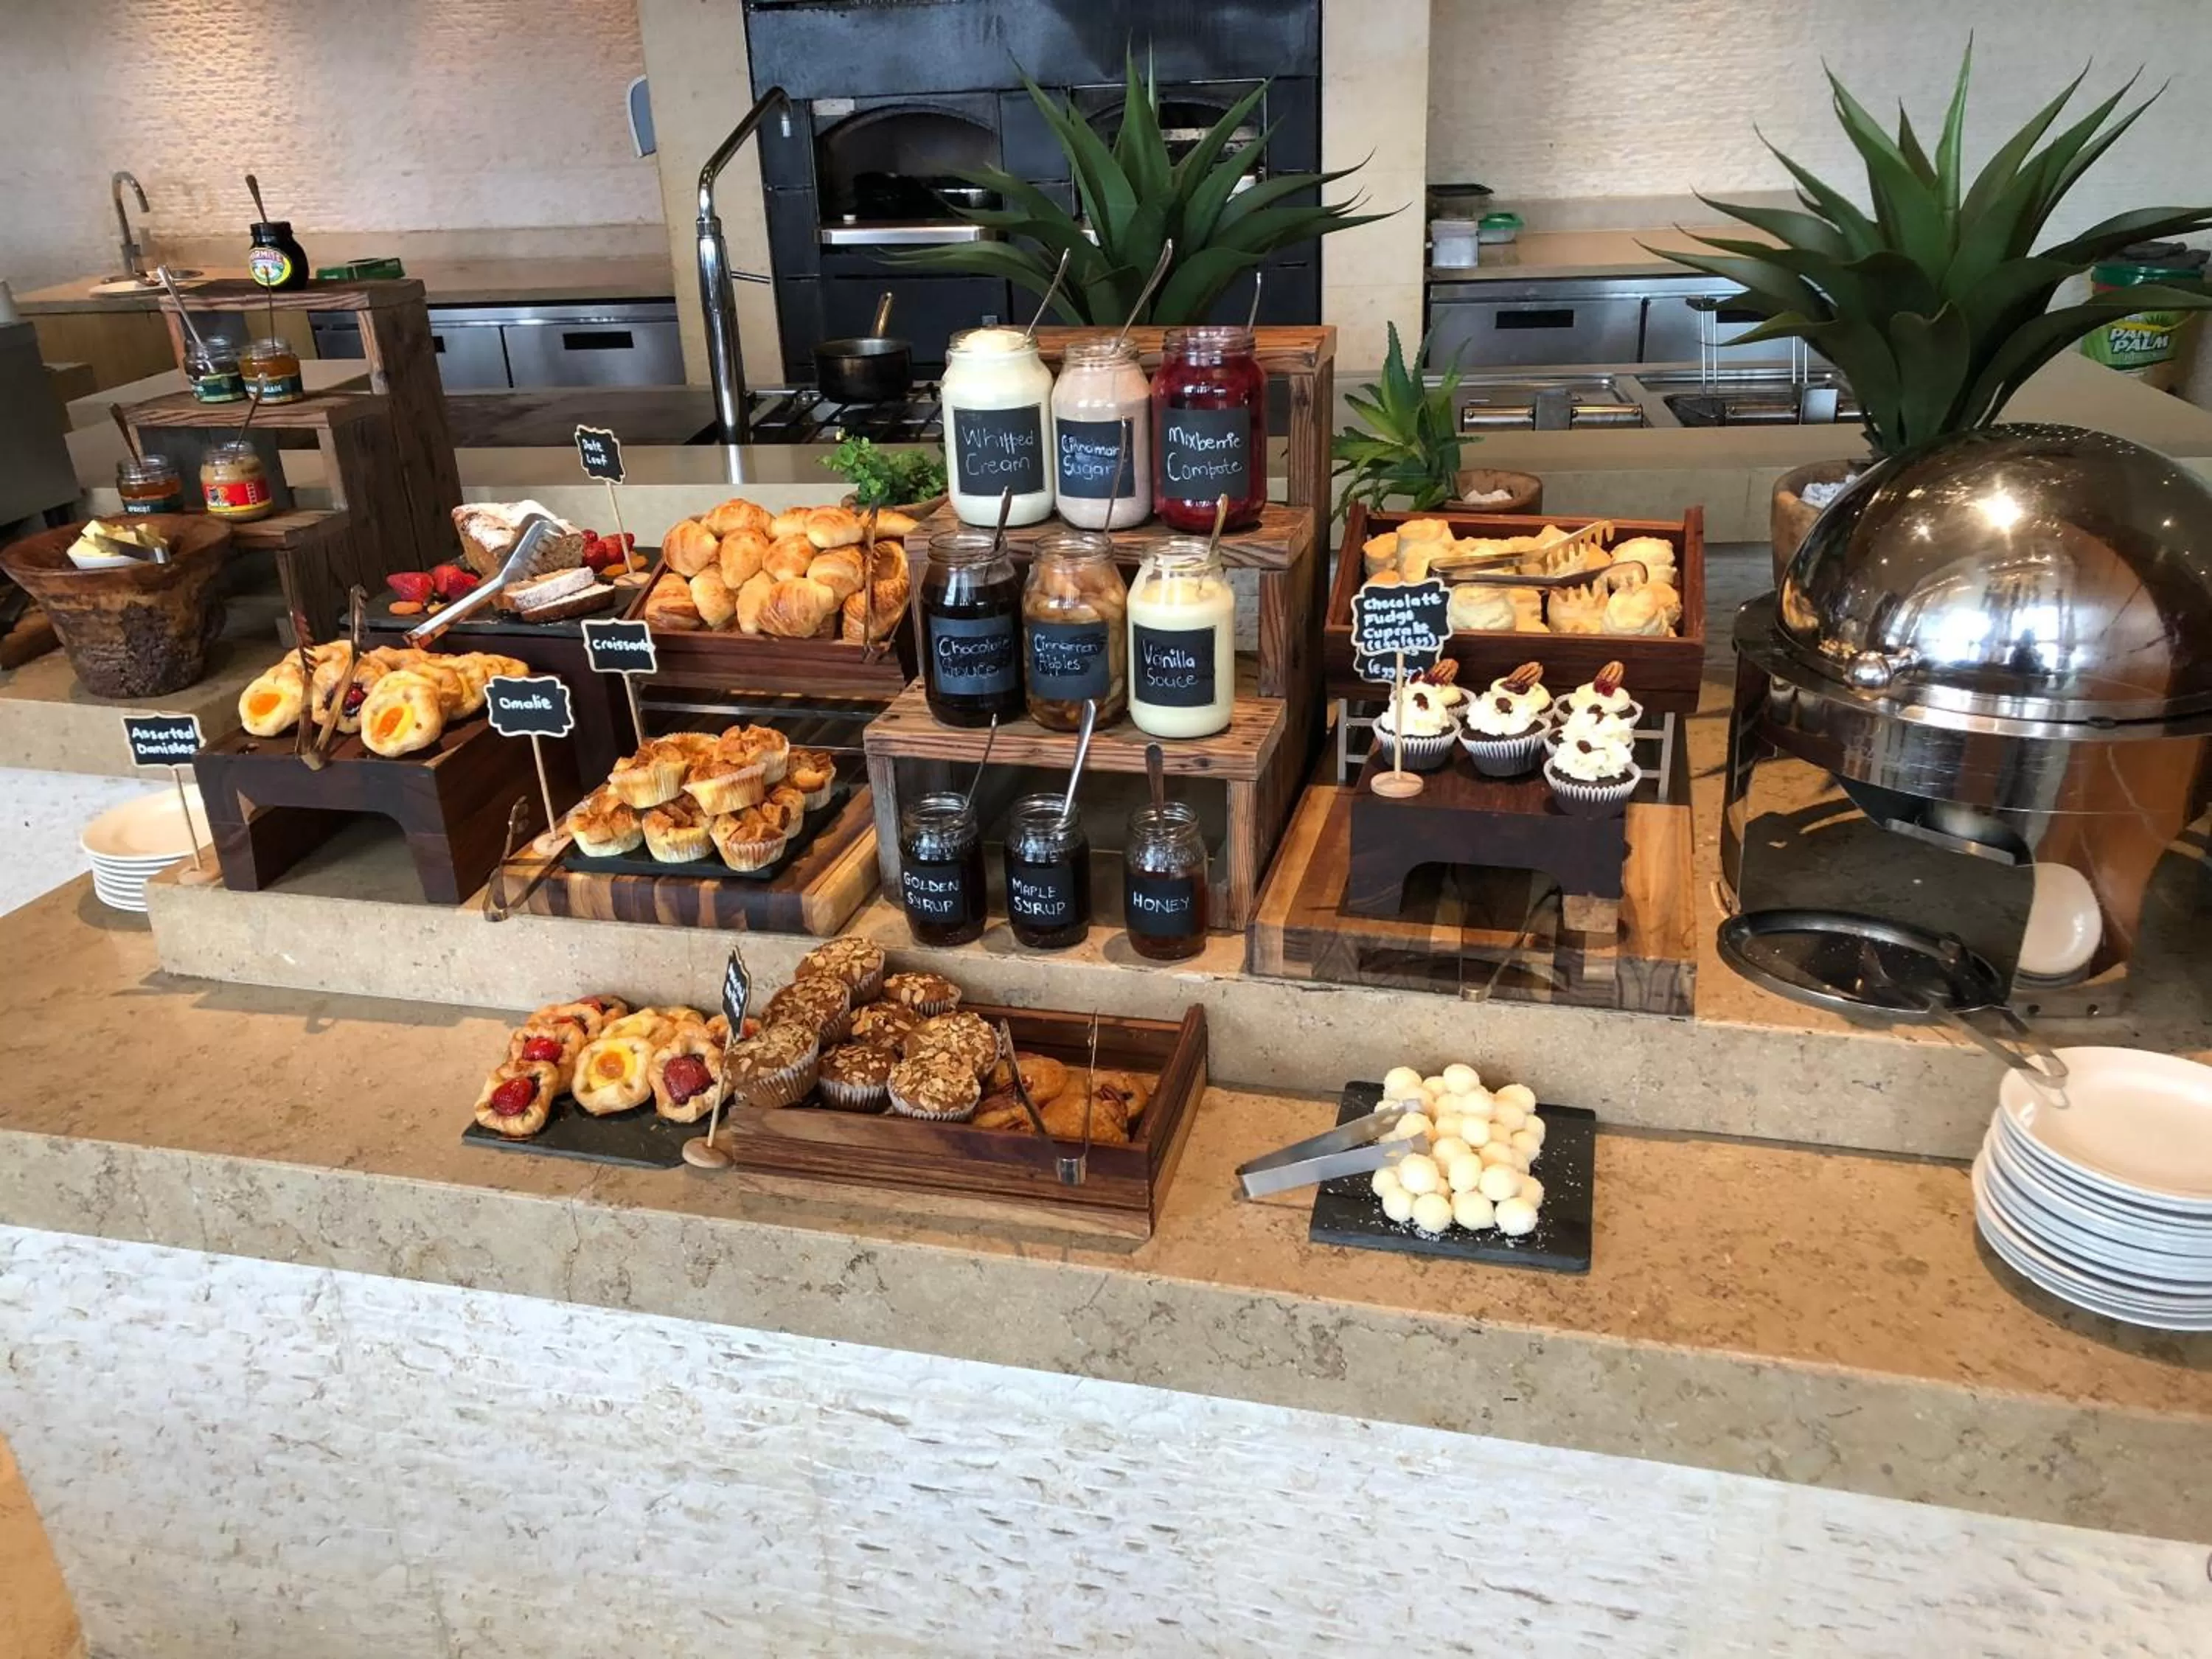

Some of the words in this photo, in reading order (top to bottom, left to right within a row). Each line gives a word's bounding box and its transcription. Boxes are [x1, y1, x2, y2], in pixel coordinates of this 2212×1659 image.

[966, 452, 1030, 476] Cream
[1167, 452, 1243, 481] Compote
[1364, 593, 1442, 610] Chocolate
[1364, 610, 1414, 626] Fudge
[1142, 639, 1196, 668] Vanilla
[903, 872, 959, 892] GOLDEN
[1012, 877, 1056, 899] MAPLE
[908, 891, 953, 913] SYRUP
[1014, 896, 1066, 915] SYRUP
[1133, 891, 1190, 913] HONEY
